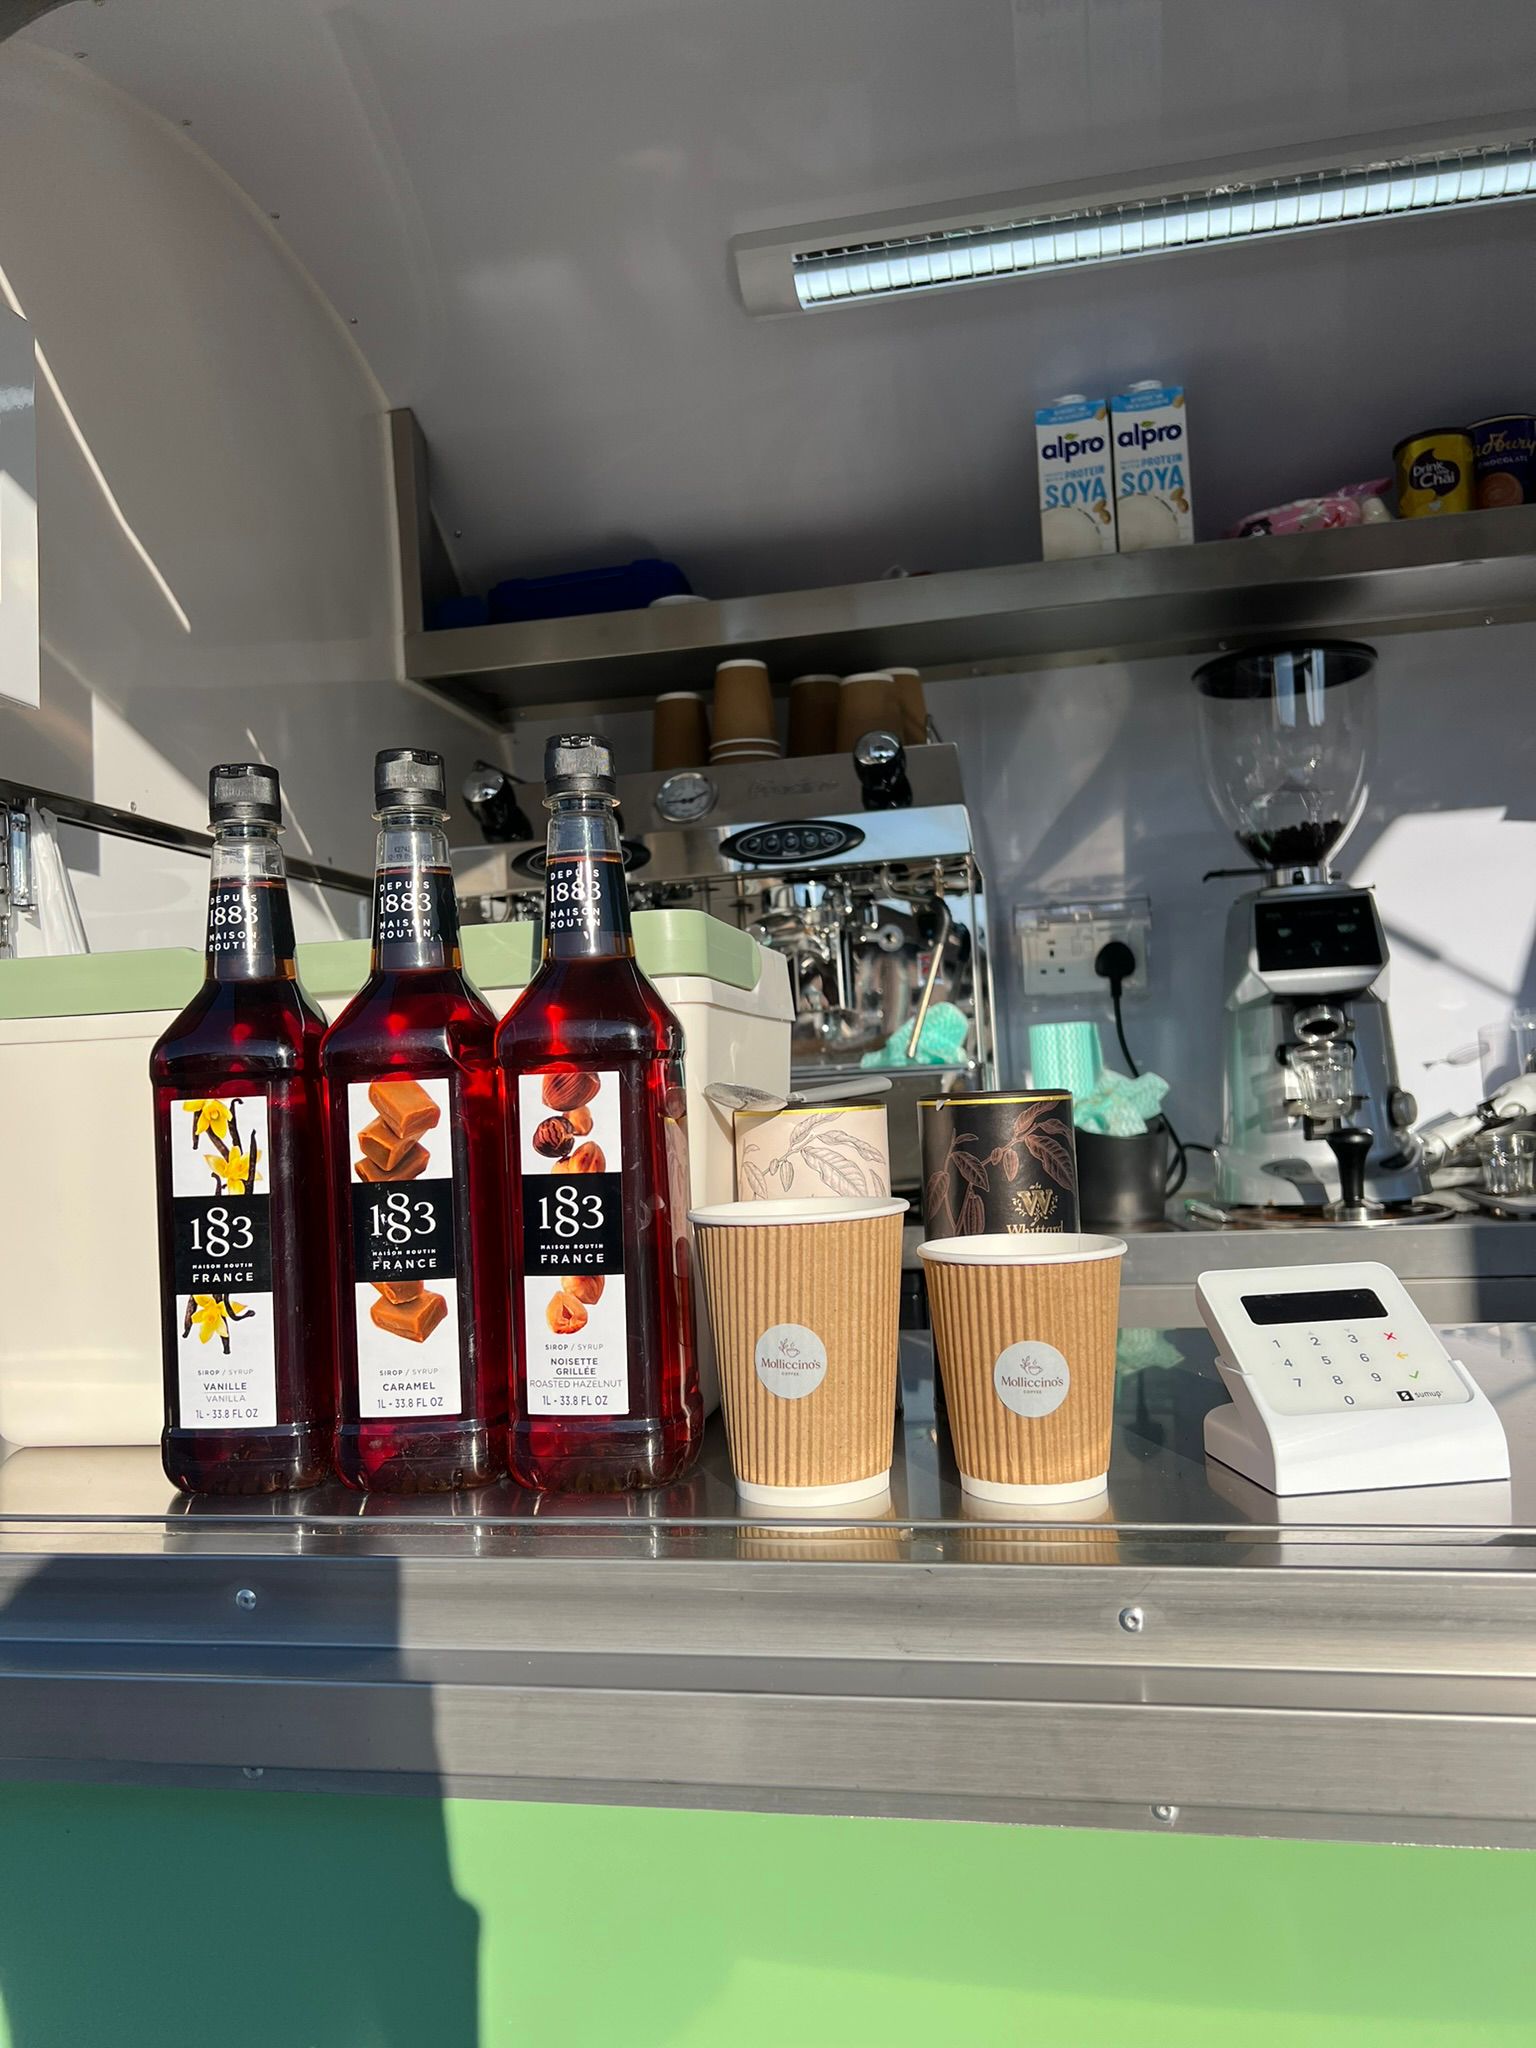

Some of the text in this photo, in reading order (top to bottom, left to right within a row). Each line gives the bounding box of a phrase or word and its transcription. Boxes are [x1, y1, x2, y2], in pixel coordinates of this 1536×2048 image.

[1117, 422, 1182, 450] alpro
[1042, 434, 1105, 463] alpro
[1140, 453, 1183, 466] PROTEIN
[1064, 465, 1105, 479] PROTEIN
[1413, 461, 1445, 477] Drink
[1120, 464, 1184, 497] SOYA
[1419, 471, 1455, 488] Chai
[1044, 476, 1107, 509] SOYA
[550, 869, 600, 880] DEPUS
[379, 881, 430, 892] DEPUS
[550, 880, 601, 903] 1883
[210, 894, 257, 905] DEPUS
[379, 892, 431, 914] 1883
[209, 905, 258, 927] 1883
[550, 907, 600, 919] MAISON
[550, 918, 600, 930] ROUTN
[380, 929, 431, 940] ROUTN
[372, 1258, 437, 1270] FRANCE
[540, 1253, 604, 1264] FRANCE
[192, 1271, 254, 1283] FRANCE
[545, 1343, 569, 1351] SIROP
[577, 1343, 604, 1351] SYRUP
[1272, 1334, 1358, 1348] 1 2 3
[550, 1357, 598, 1366] NOISETTE
[761, 1357, 821, 1370] Molliccino's
[1283, 1353, 1370, 1368] 4 5 6
[412, 1367, 439, 1375] SYRUP
[556, 1366, 596, 1375] GRILLÉE
[529, 1379, 622, 1388] ROASTED HAZELNUT
[1001, 1375, 1064, 1388] Molliccino's
[1293, 1372, 1382, 1387] 7 8 9
[203, 1382, 247, 1391] VANILLE
[382, 1381, 436, 1391] CARAMEL
[205, 1394, 246, 1403] VANILLA
[542, 1395, 551, 1405] 1L
[560, 1395, 578, 1405] 33.8
[581, 1395, 592, 1405] FL
[595, 1395, 608, 1405] OZ
[1344, 1395, 1355, 1405] 0
[1414, 1389, 1443, 1399] sumup
[377, 1399, 386, 1408] 1L
[395, 1398, 414, 1408] 33.8
[417, 1397, 427, 1407] FL
[430, 1396, 443, 1407] OZ
[195, 1409, 204, 1419] 1L
[212, 1409, 230, 1419] 33.8
[232, 1408, 243, 1418] FL
[245, 1408, 258, 1418] OZ
